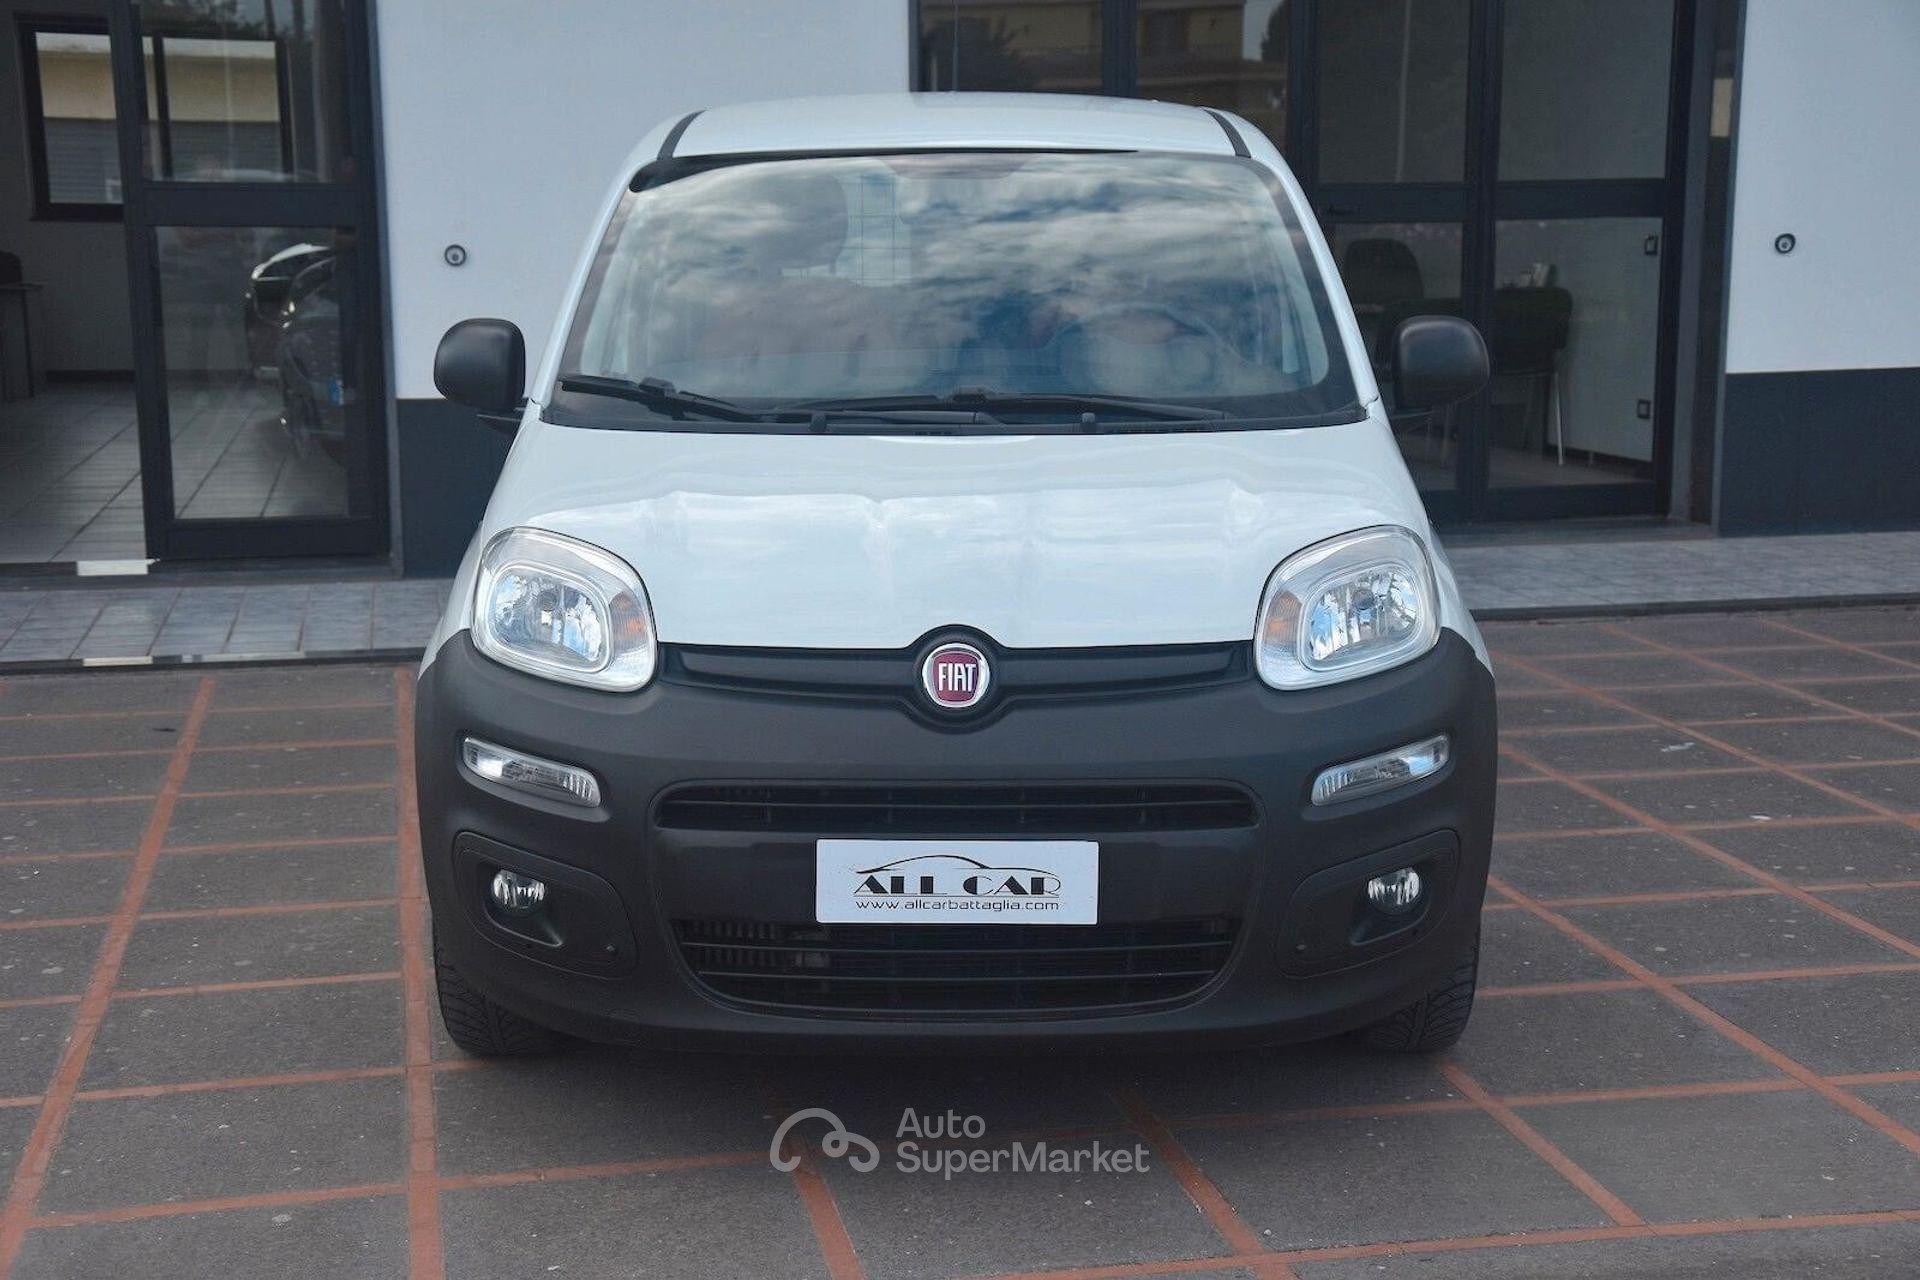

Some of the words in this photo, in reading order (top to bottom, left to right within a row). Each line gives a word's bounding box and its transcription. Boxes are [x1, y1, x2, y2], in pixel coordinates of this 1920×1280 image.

[938, 662, 977, 692] FIAT
[853, 874, 948, 896] ALL
[962, 874, 1061, 896] CAR
[855, 899, 1059, 912] www.allcarbattaglia.com
